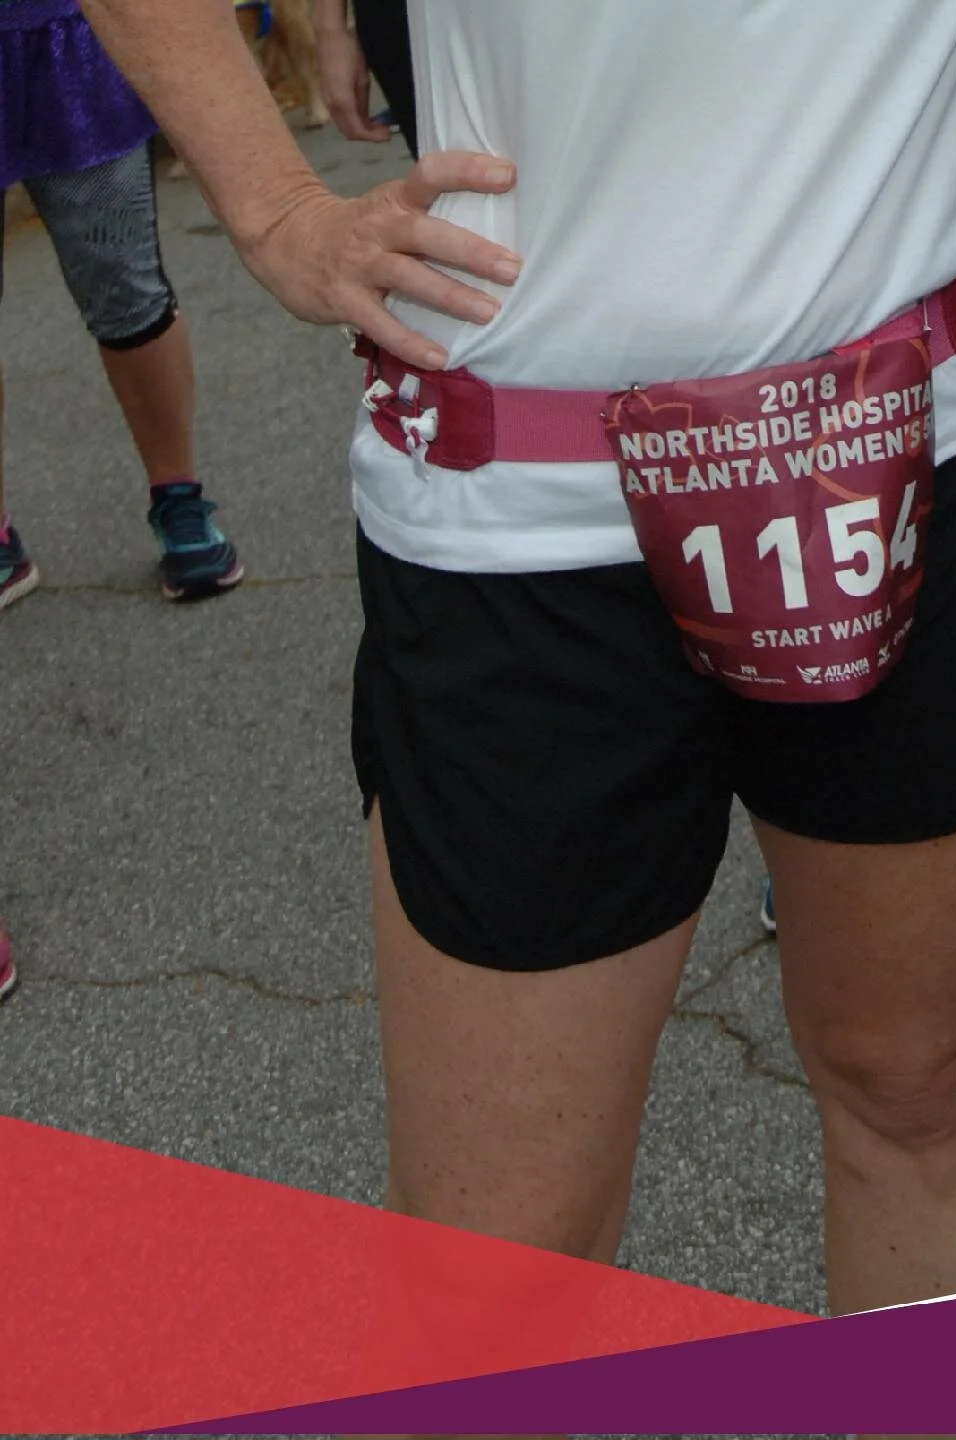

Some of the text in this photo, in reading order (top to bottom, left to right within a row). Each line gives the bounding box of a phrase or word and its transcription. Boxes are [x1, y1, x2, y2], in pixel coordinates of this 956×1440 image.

[619, 380, 932, 461] NORTHSIDE HOSPITA
[758, 373, 837, 413] 2018
[626, 457, 779, 495] ATLANTA
[784, 423, 921, 480] WOMEN'S
[681, 479, 917, 614] 1154
[752, 625, 822, 648] START
[829, 611, 883, 640] WAVE
[824, 657, 870, 677] ATLANTA
